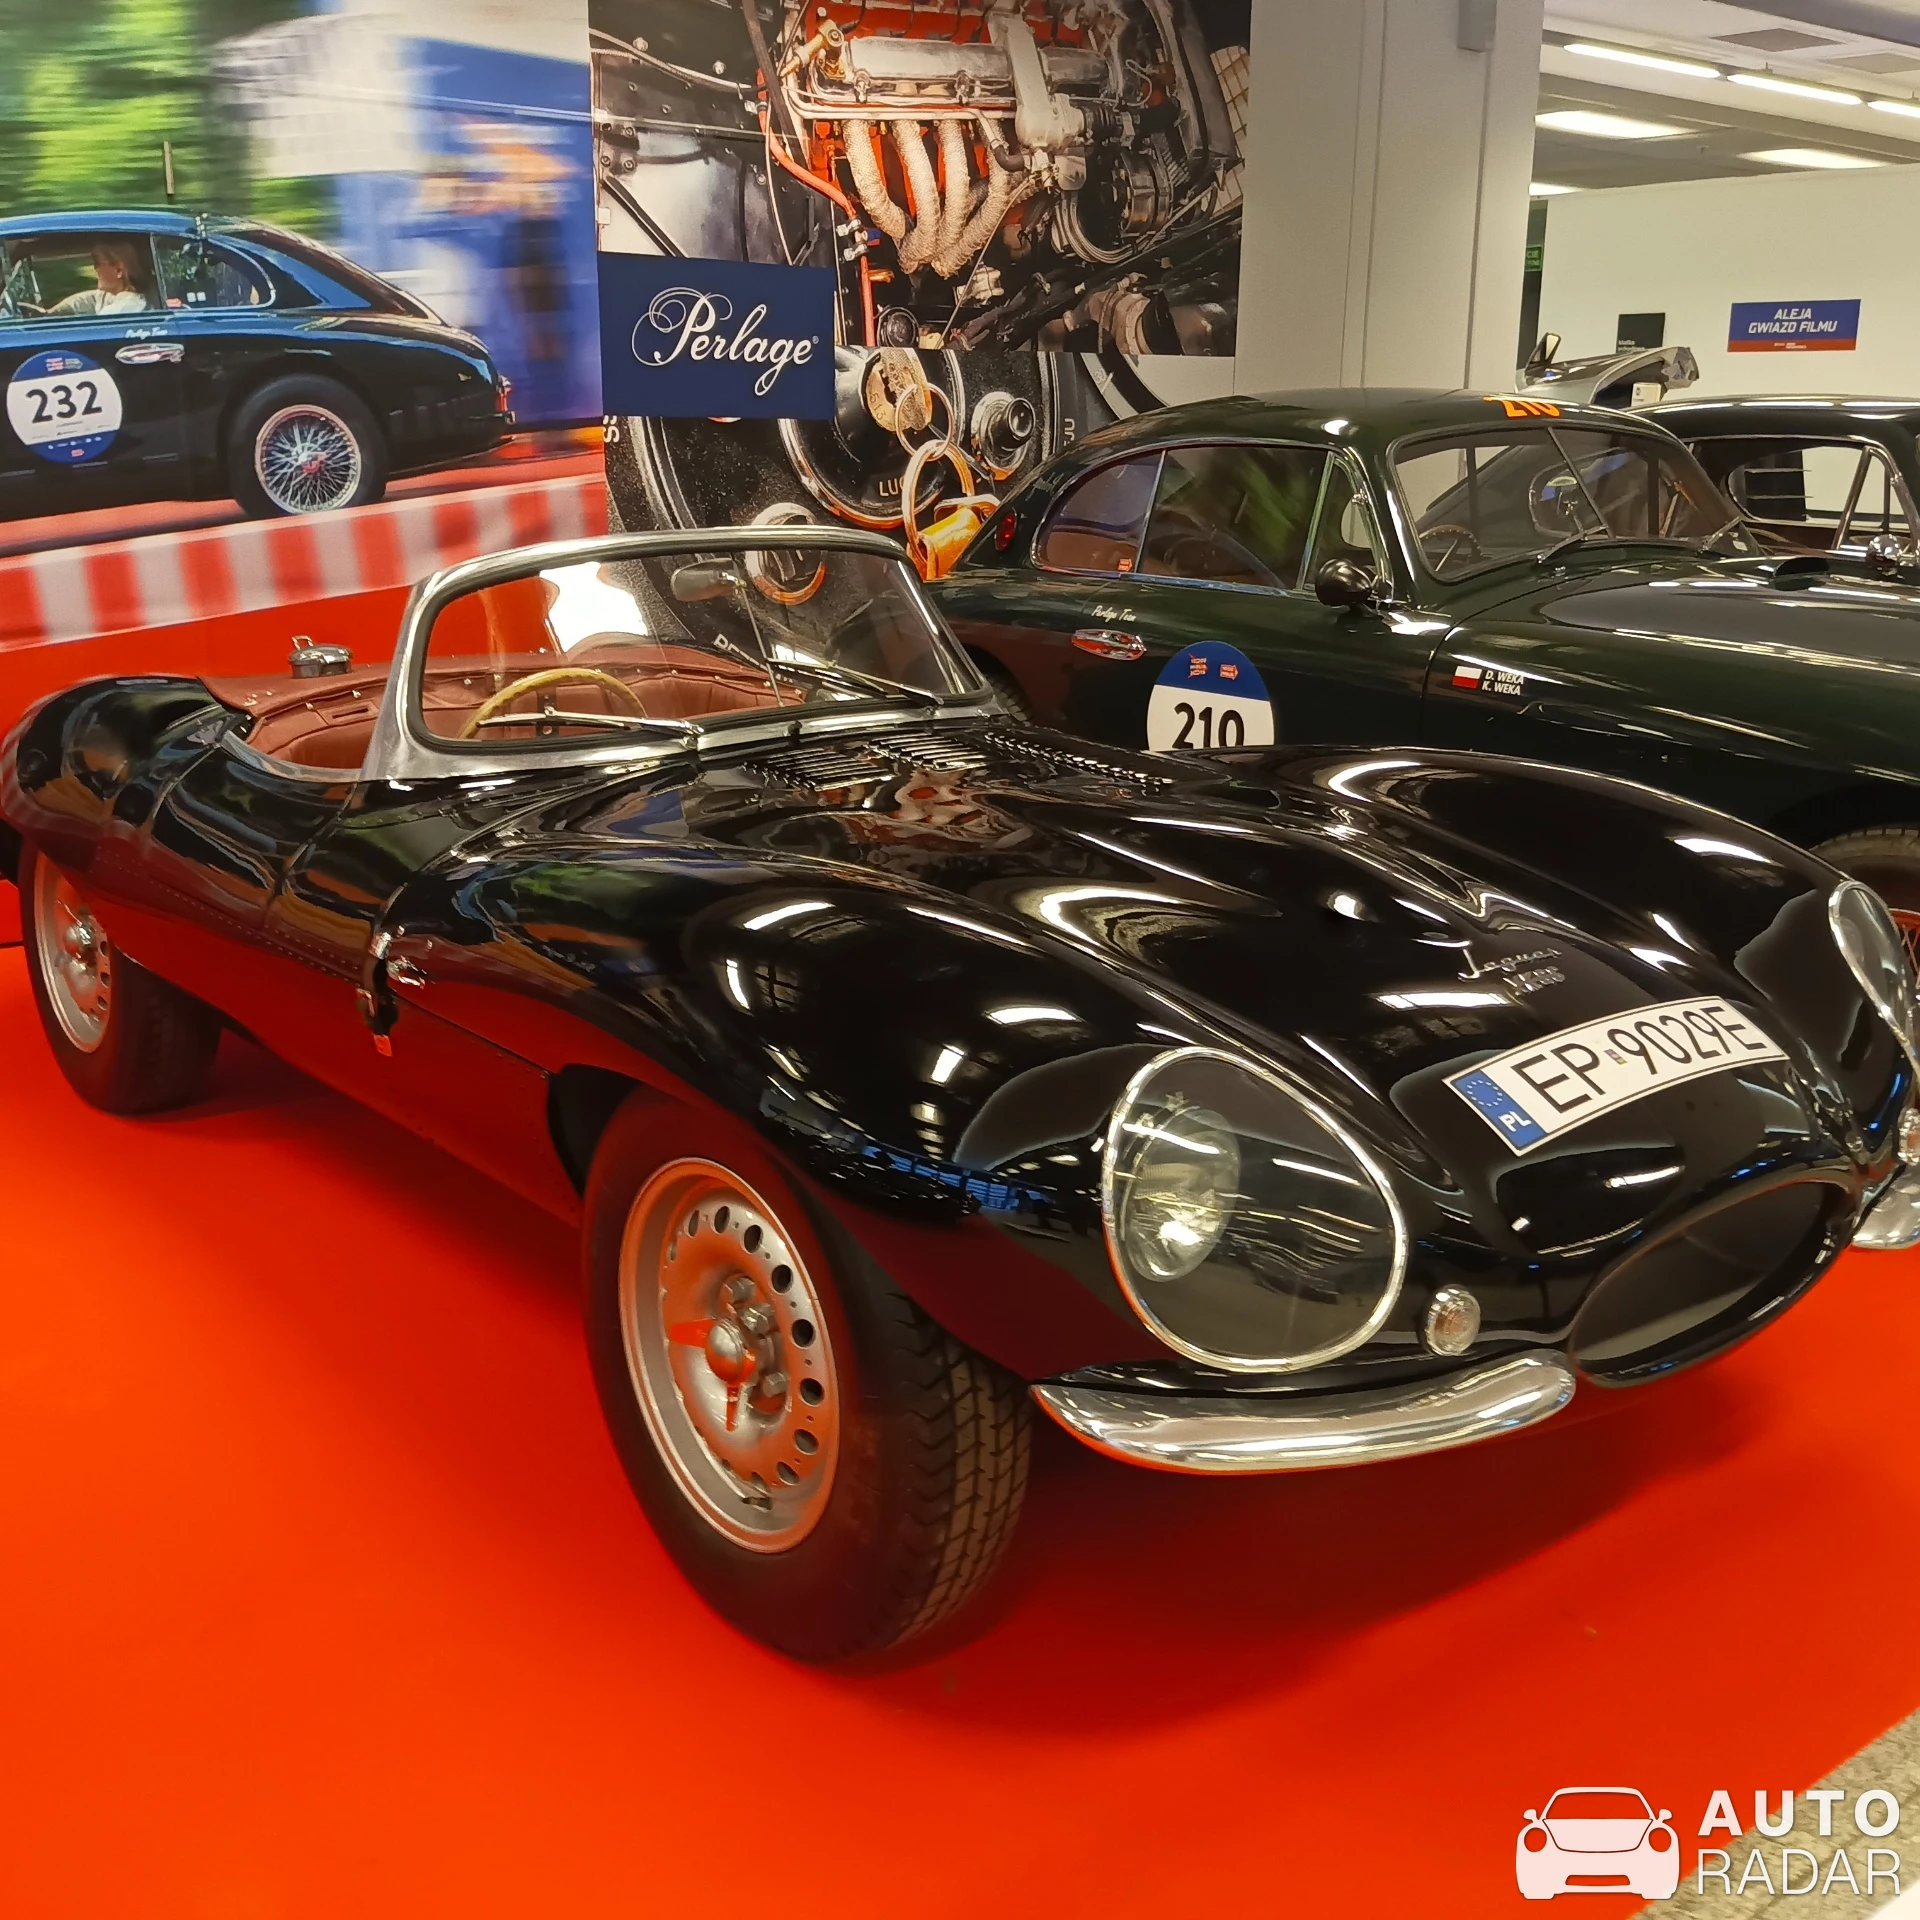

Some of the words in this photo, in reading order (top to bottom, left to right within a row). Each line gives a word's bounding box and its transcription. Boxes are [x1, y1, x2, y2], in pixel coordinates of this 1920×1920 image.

[1774, 308, 1812, 320] ALEJA
[1748, 321, 1797, 333] GWIAZD
[1799, 320, 1838, 333] FILMU
[25, 381, 103, 423] 232
[1485, 670, 1494, 681] D.
[1497, 672, 1524, 684] WEKA
[1482, 681, 1491, 692] K.
[1494, 683, 1521, 695] WEKA
[1171, 702, 1245, 750] 210
[1510, 1043, 1606, 1114] EP
[1607, 1006, 1767, 1075] 9029E
[1498, 1110, 1532, 1132] PL
